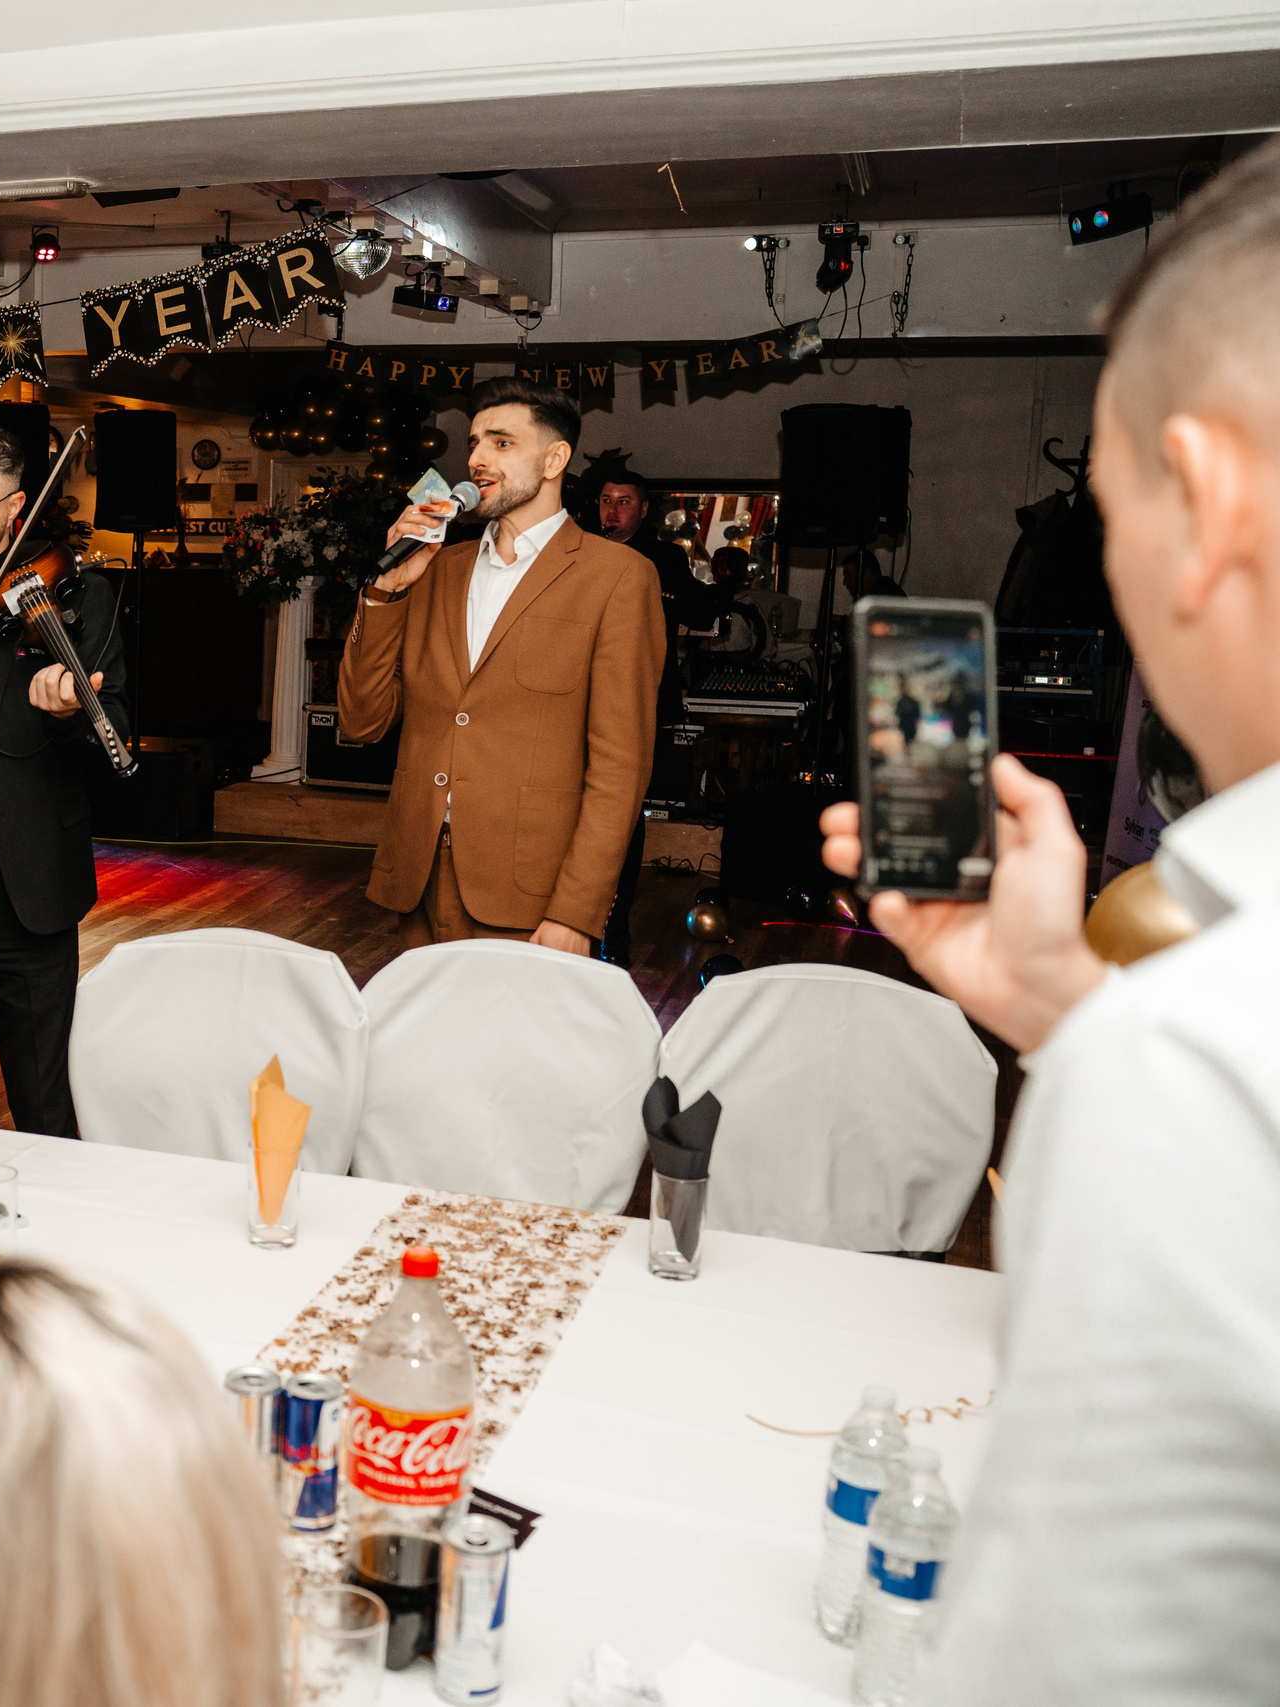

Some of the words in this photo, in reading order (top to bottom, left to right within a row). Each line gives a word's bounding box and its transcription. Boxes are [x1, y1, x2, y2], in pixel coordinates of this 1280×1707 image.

[94, 246, 325, 348] YEAR
[326, 349, 470, 389] HAPPY
[648, 340, 783, 382] YEAR
[312, 714, 334, 725] THON
